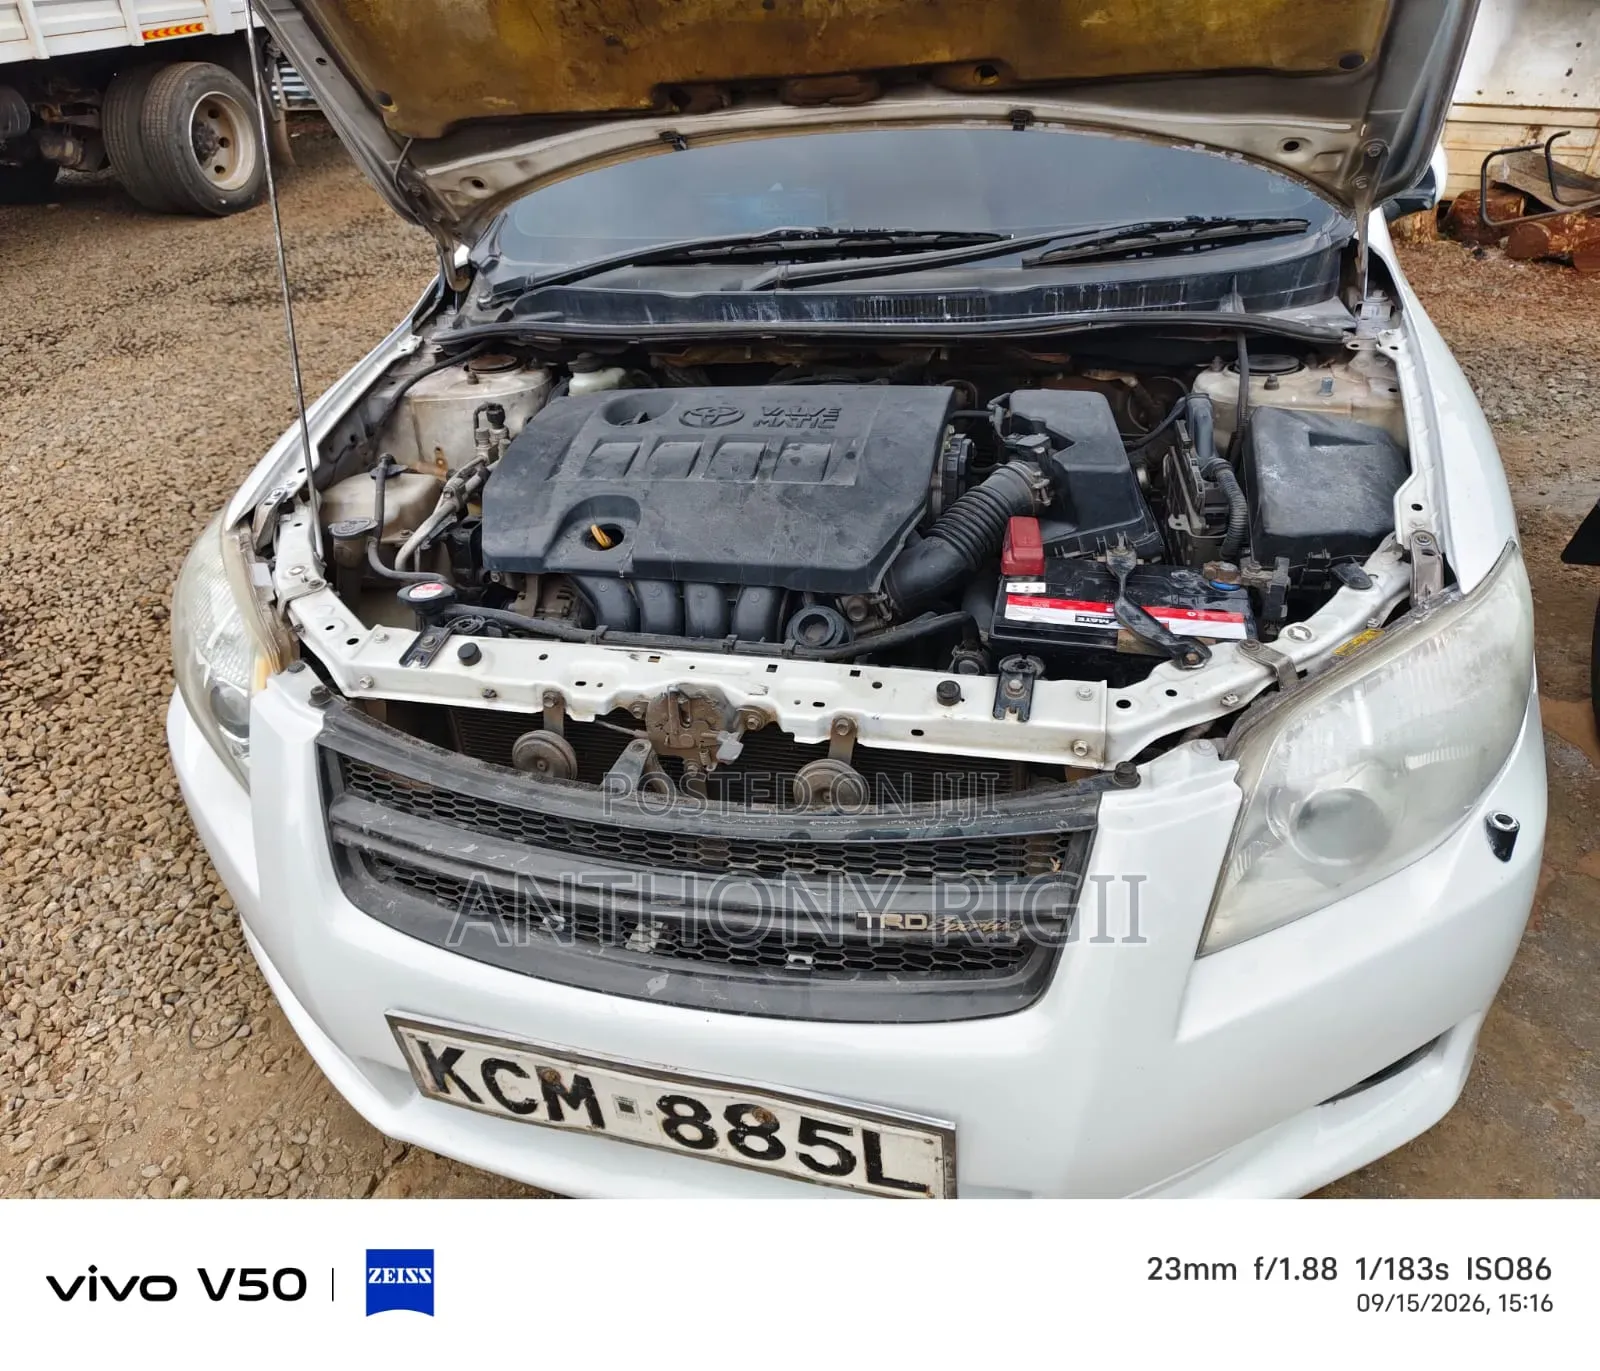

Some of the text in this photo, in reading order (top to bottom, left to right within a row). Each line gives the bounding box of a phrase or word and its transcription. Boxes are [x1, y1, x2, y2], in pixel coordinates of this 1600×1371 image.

[761, 406, 842, 417] VALVE
[752, 416, 838, 429] MATIC
[857, 912, 928, 930] TRD
[416, 1039, 930, 1194] KCM 885L
